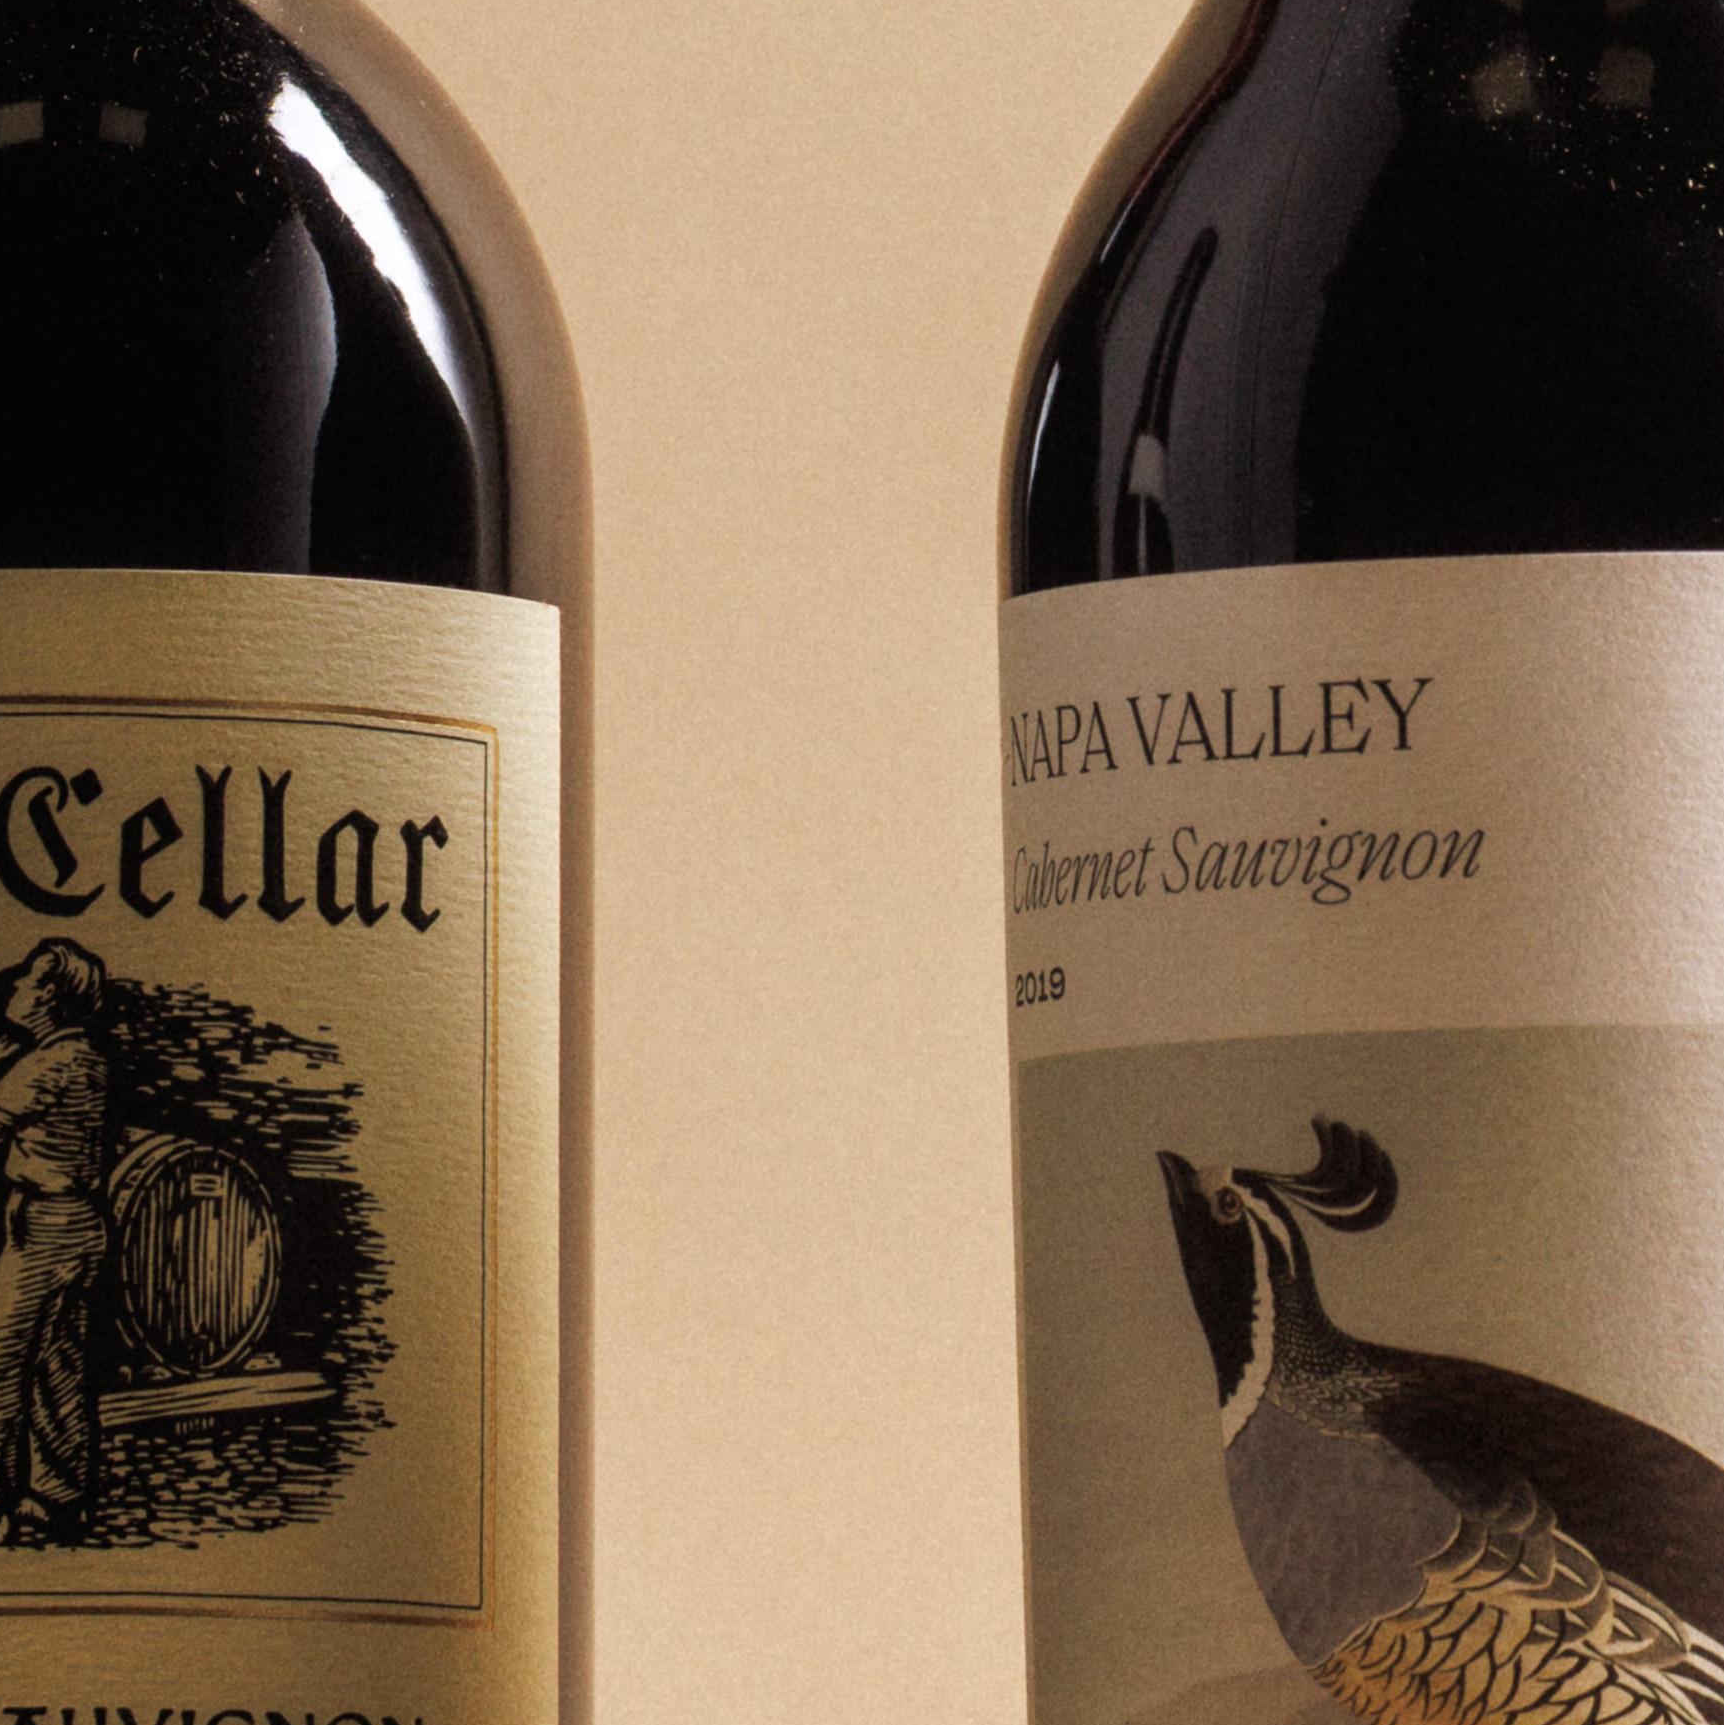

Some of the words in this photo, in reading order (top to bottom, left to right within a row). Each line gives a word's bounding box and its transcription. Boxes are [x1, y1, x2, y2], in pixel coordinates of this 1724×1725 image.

[1009, 700, 1119, 787] NAPA
[1127, 677, 1432, 766] VALLEY
[1012, 837, 1155, 916] Cabernet
[1161, 817, 1486, 906] Sauvignon
[1015, 966, 1066, 1008] 2019
